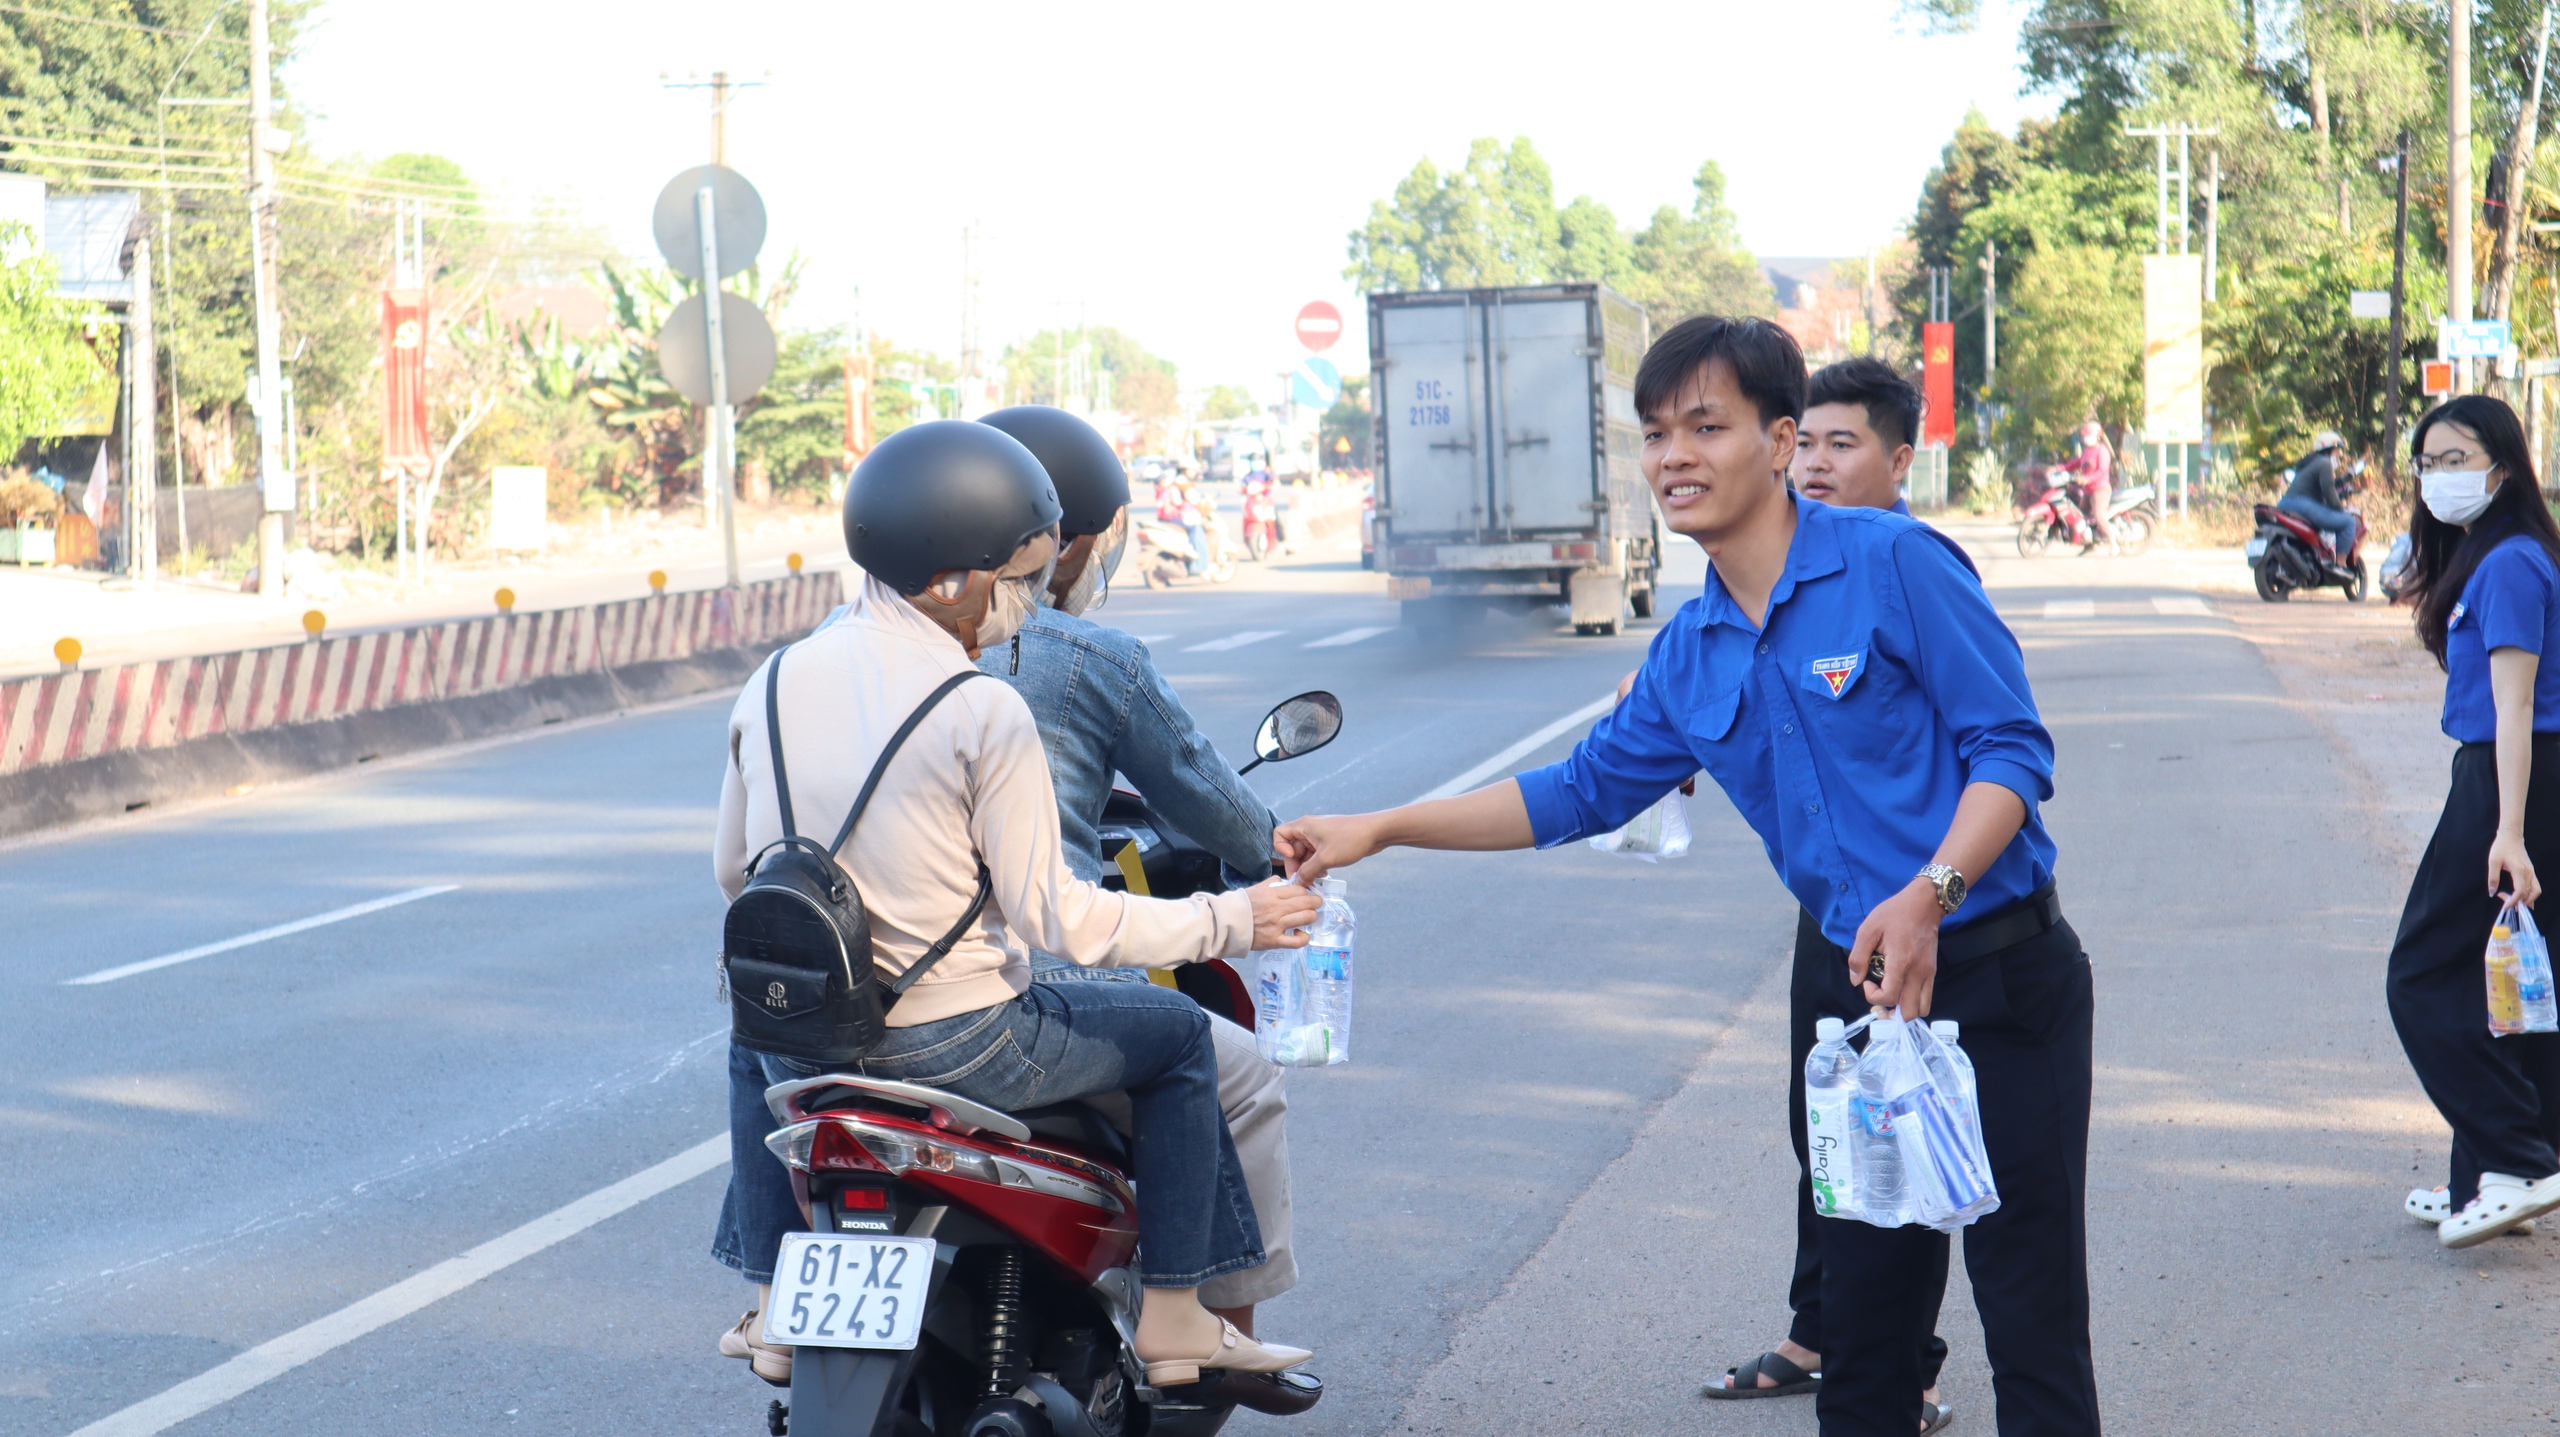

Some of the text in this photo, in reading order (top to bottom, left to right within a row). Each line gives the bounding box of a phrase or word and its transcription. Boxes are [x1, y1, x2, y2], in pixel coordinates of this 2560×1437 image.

[1416, 380, 1441, 400] 51C
[1410, 405, 1450, 426] 21758
[1016, 1146, 1054, 1164] AIR
[1811, 1135, 1838, 1182] Daily
[1046, 1175, 1080, 1188] ADVANCED
[841, 1220, 889, 1231] HONDA
[799, 1242, 909, 1290] 61-X2
[788, 1291, 899, 1340] 5243
